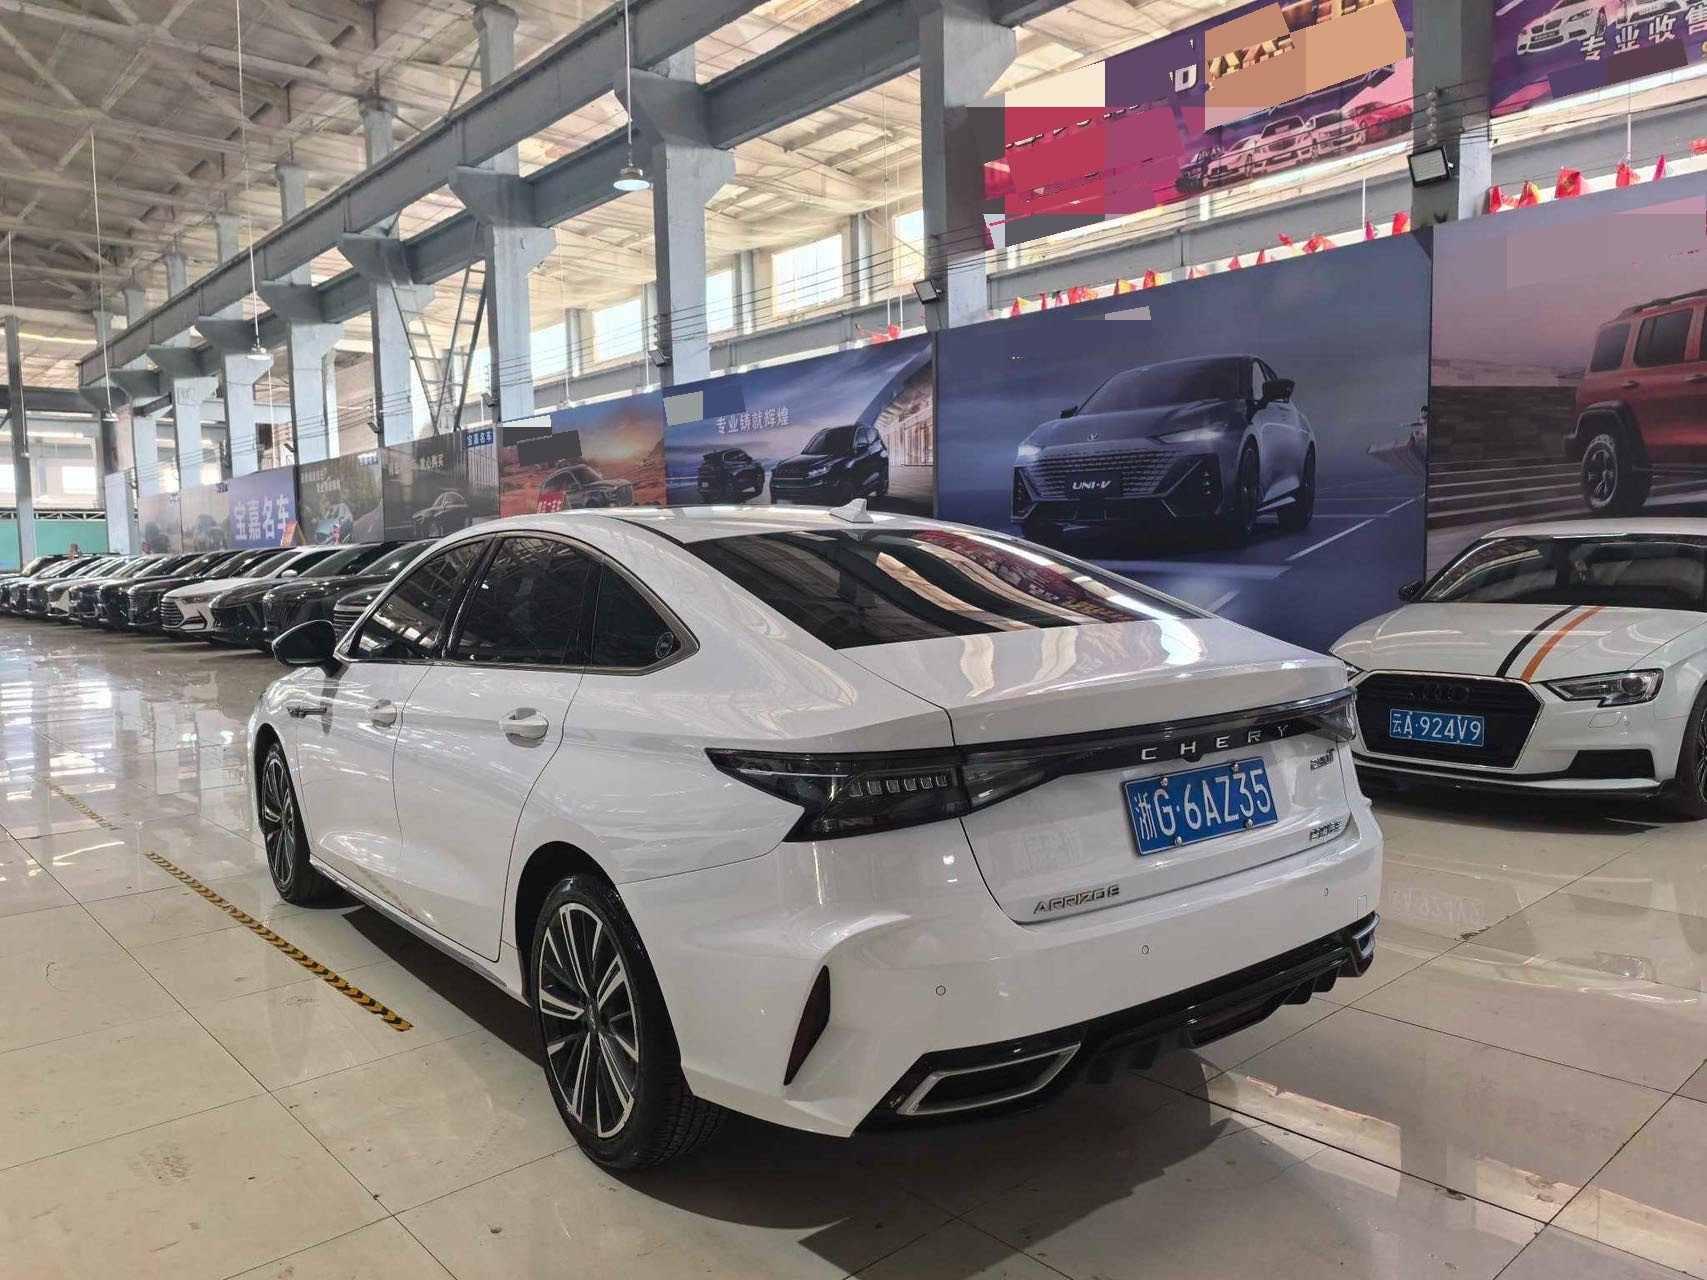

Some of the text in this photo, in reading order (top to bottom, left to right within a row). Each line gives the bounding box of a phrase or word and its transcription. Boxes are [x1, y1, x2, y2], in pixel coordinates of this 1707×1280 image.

[716, 406, 790, 434] 专业铸就辉煌
[1072, 481, 1111, 491] UNI-V
[234, 493, 290, 541] 宝嘉名车
[1140, 724, 1290, 761] CHERY
[1033, 887, 1106, 915] ARRIZO
